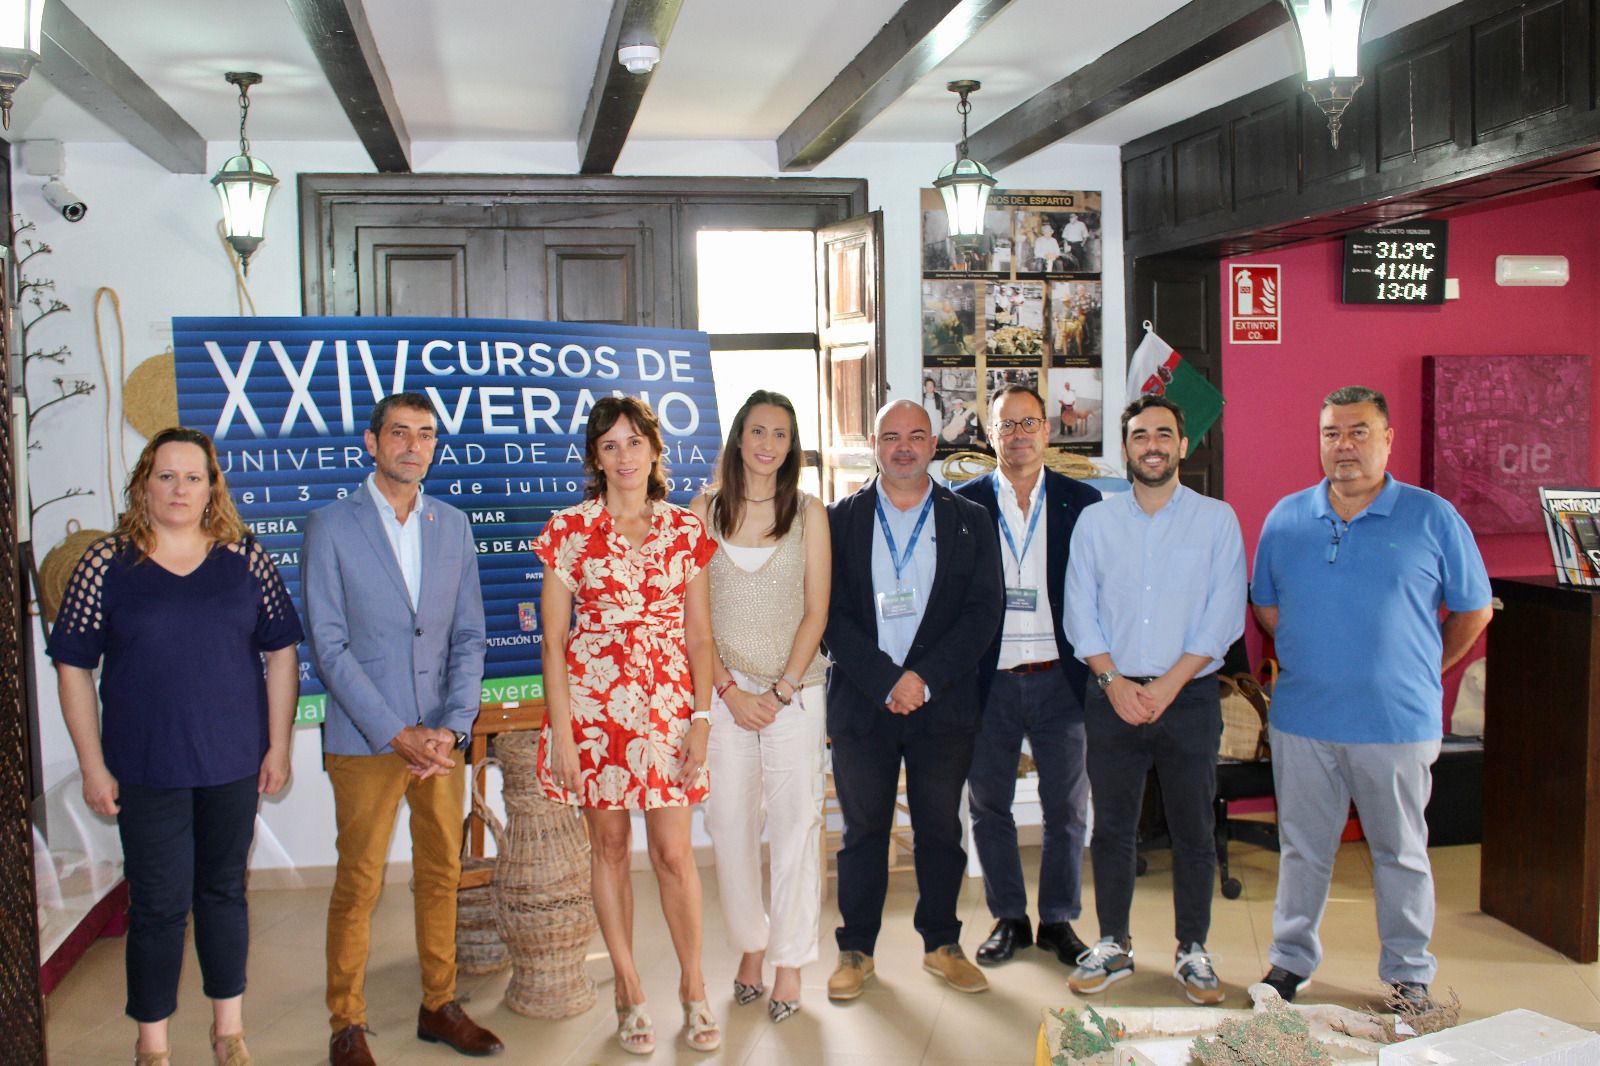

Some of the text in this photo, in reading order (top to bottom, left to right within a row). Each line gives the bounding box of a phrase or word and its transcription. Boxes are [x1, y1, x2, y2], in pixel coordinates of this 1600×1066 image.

[1011, 196, 1028, 205] DEL
[1029, 196, 1071, 206] ESPARTO
[1377, 282, 1427, 300] 13:04
[1235, 321, 1276, 330] EXTINTOR
[203, 339, 695, 441] XXIV CURSOS DE
[221, 440, 706, 474] UNIVERAD DE ARÍA
[242, 477, 709, 504] el 3 a de julio 023
[245, 511, 505, 534] MERÍA MAR
[492, 541, 513, 553] DE
[487, 634, 531, 647] UTACIÓN
